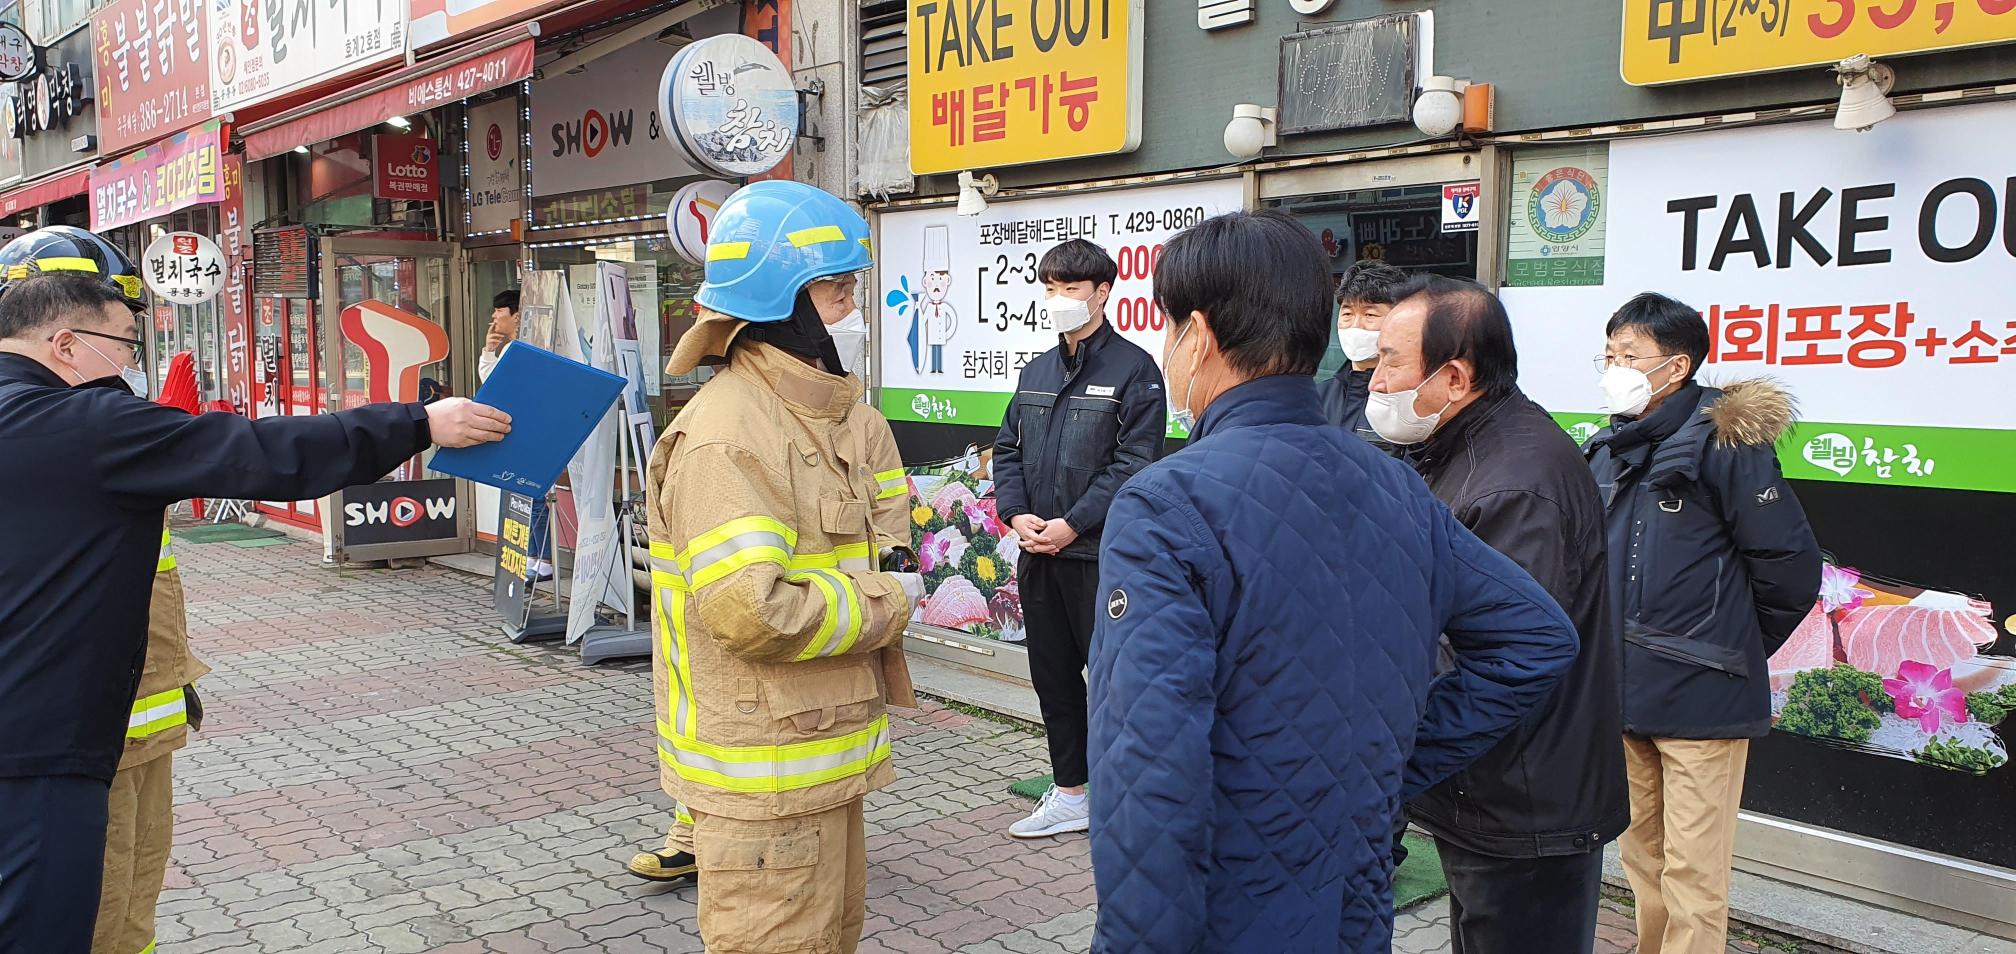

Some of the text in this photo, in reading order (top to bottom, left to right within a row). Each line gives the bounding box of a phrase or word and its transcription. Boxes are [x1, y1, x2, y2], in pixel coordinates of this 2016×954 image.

[345, 28, 381, 58] 호계2호점
[916, 0, 1014, 74] TAKE
[408, 57, 508, 106] 비에스통신 427-4011
[690, 61, 735, 96] 웰빙
[719, 99, 791, 152] 참치
[932, 71, 1098, 147] 배달가능
[552, 108, 659, 158] SHOW &
[96, 145, 216, 226] 멸치국수 & 코다리조림
[388, 162, 428, 179] Lotto
[389, 180, 429, 193] 복권판매점
[472, 192, 482, 207] LG
[979, 206, 1205, 247] 포장배달해드립니다 T. 429-0860
[1666, 183, 1903, 271] TAKE
[151, 255, 221, 286] 멸치국수
[1516, 260, 1604, 277] 모범음식점
[962, 350, 1008, 380] 참치회
[1808, 436, 1935, 480] 웰빙 참치
[345, 496, 456, 526] SHOW
